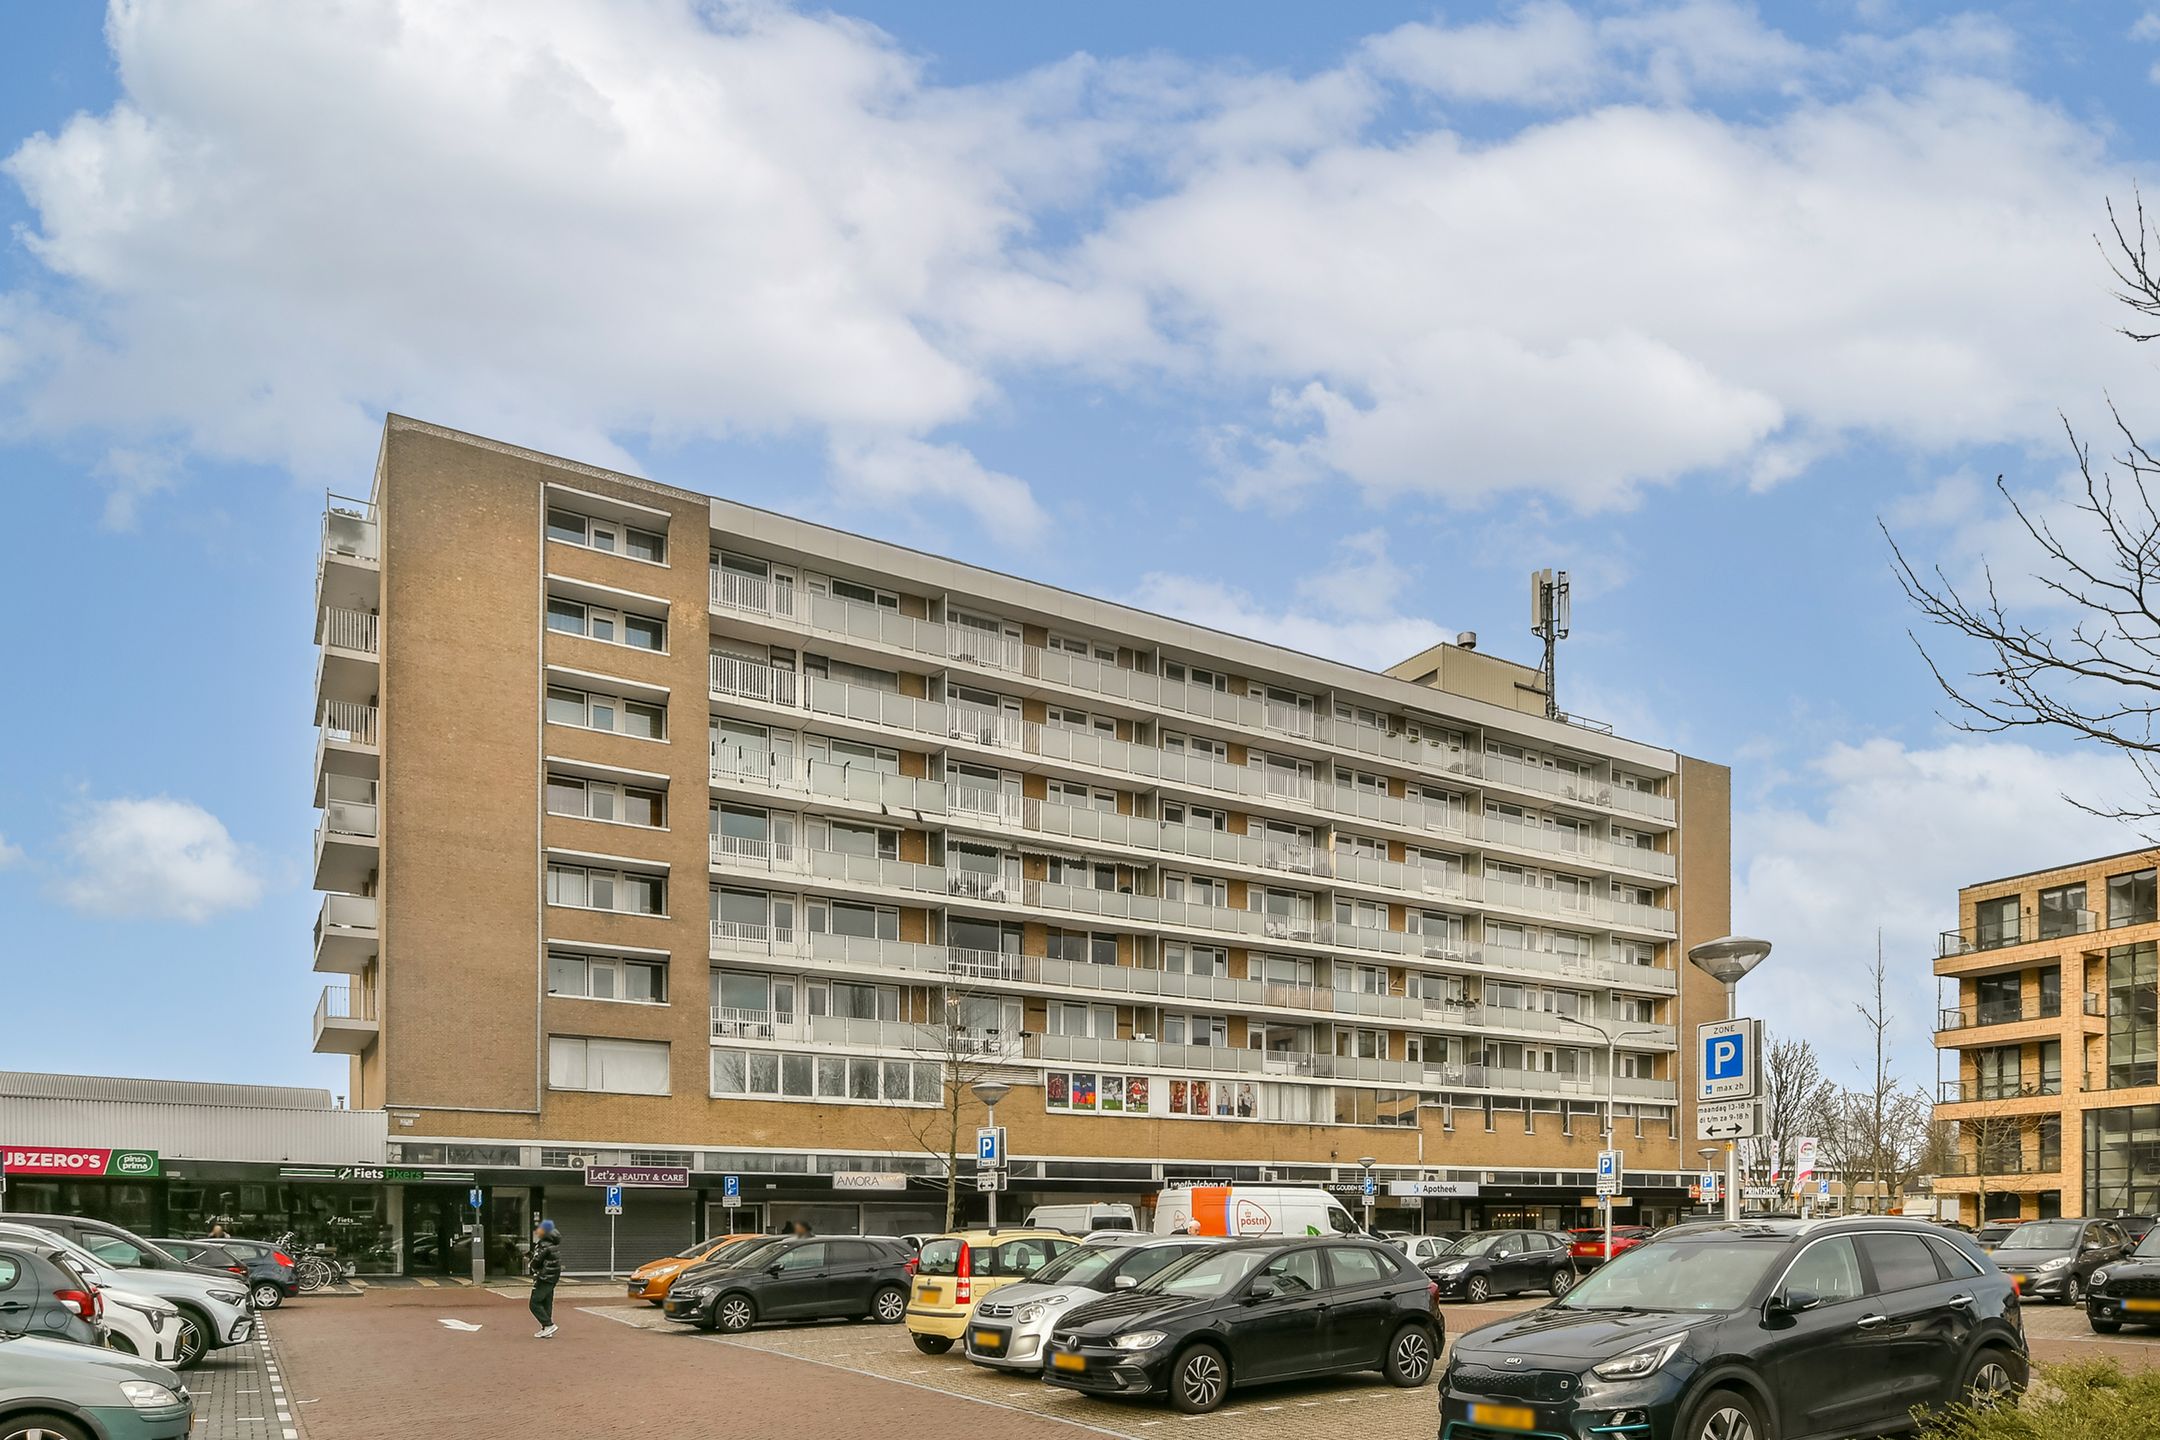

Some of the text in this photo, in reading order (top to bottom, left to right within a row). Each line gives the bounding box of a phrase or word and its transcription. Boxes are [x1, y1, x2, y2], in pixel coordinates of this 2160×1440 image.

[1713, 1024, 1736, 1034] ZONE
[1715, 1041, 1736, 1075] P
[1716, 1084, 1733, 1092] max
[1698, 1105, 1727, 1113] maandag
[1728, 1102, 1745, 1110] 13-18
[982, 1138, 992, 1157] P
[124, 1155, 147, 1163] pinsa
[123, 1162, 148, 1170] prima
[1602, 1158, 1610, 1173] P
[353, 1167, 421, 1180] Fiets Fixers
[590, 1169, 615, 1180] Let'z
[652, 1173, 660, 1181] &
[727, 1179, 735, 1188] P
[836, 1175, 880, 1186] AMORA
[1704, 1177, 1711, 1187] P
[610, 1187, 618, 1198] P
[1422, 1184, 1458, 1195] Apotheek
[1744, 1186, 1781, 1195] PRINTSHOP
[1240, 1216, 1267, 1227] postnl
